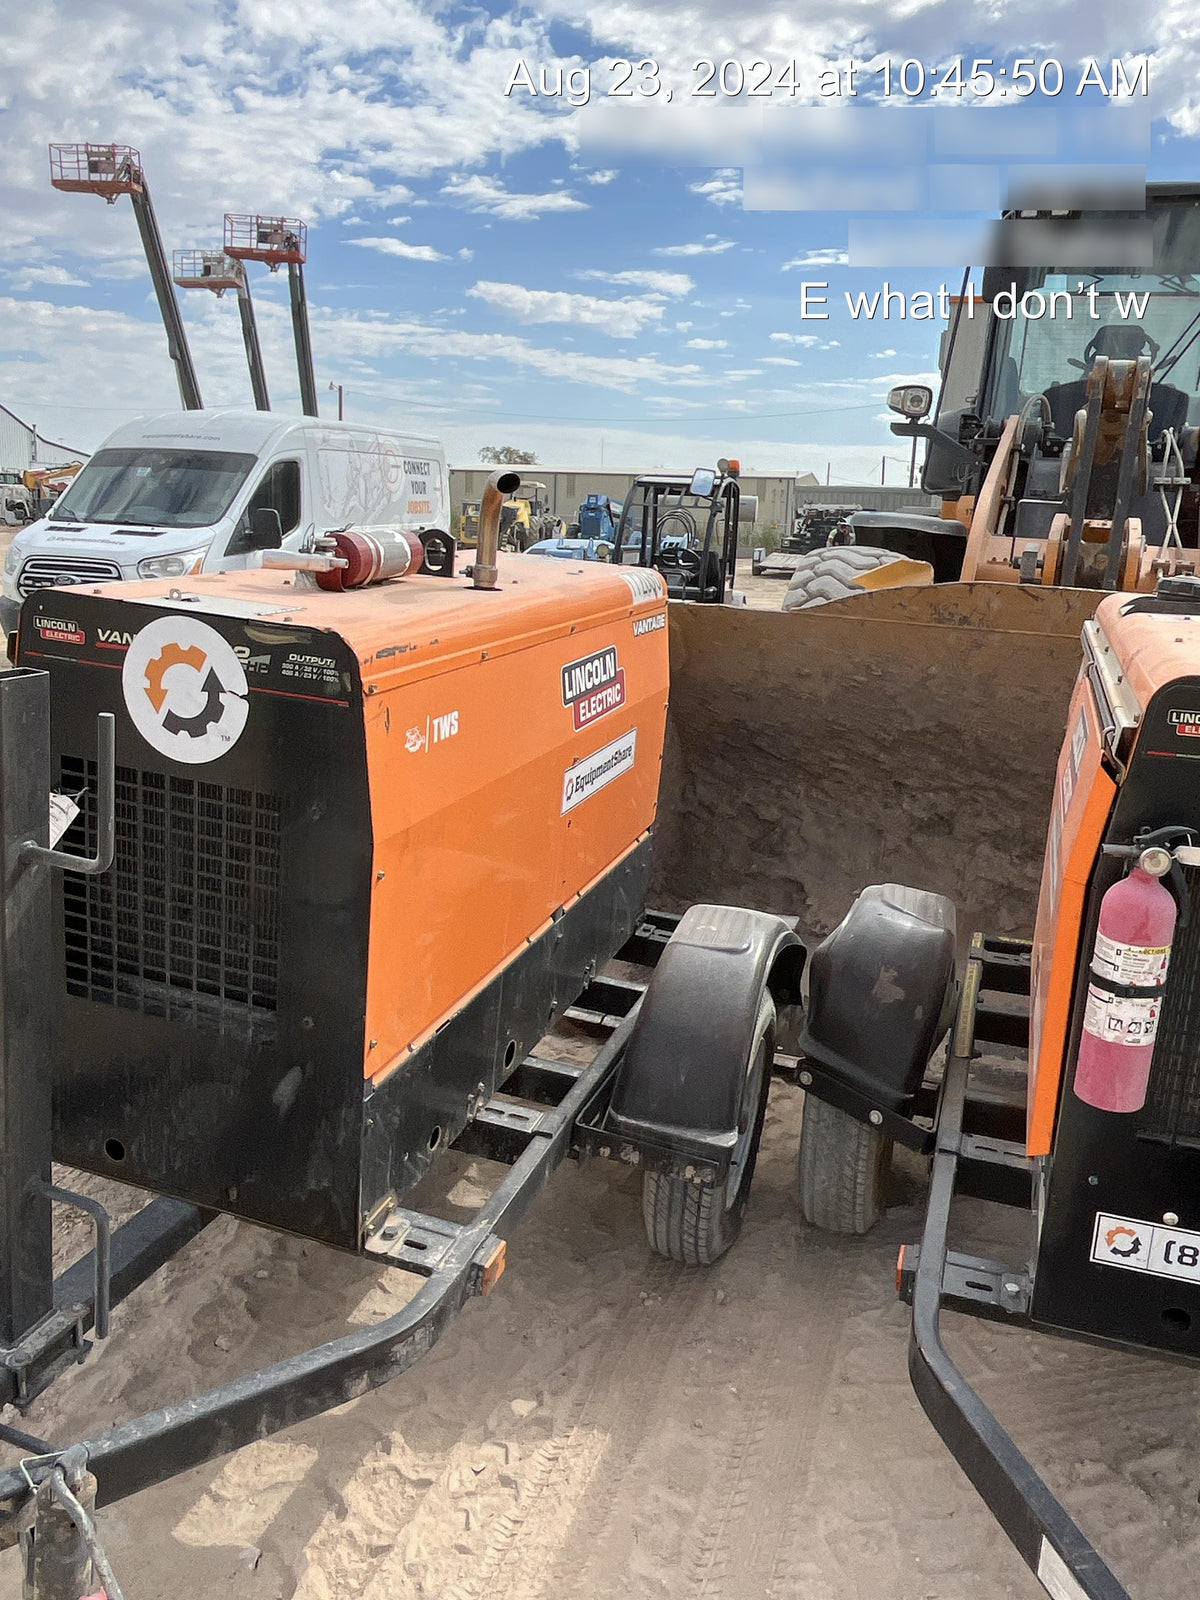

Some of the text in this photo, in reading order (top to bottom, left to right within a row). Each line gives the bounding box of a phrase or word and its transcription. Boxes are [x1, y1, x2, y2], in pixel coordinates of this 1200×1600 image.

[403, 460, 430, 475] CONNECT
[411, 480, 427, 494] YOUR
[35, 617, 76, 632] LINCOLN
[632, 612, 666, 637] VANTAGE
[45, 630, 81, 642] ELECTRIC
[97, 628, 136, 645] VAN
[289, 653, 333, 665] OUTPUT
[564, 652, 616, 700] LINCOLN
[579, 683, 622, 723] ELECTRIC
[432, 710, 459, 744] TWS
[1185, 725, 1200, 735] EL
[574, 745, 632, 793] EquipmentShare
